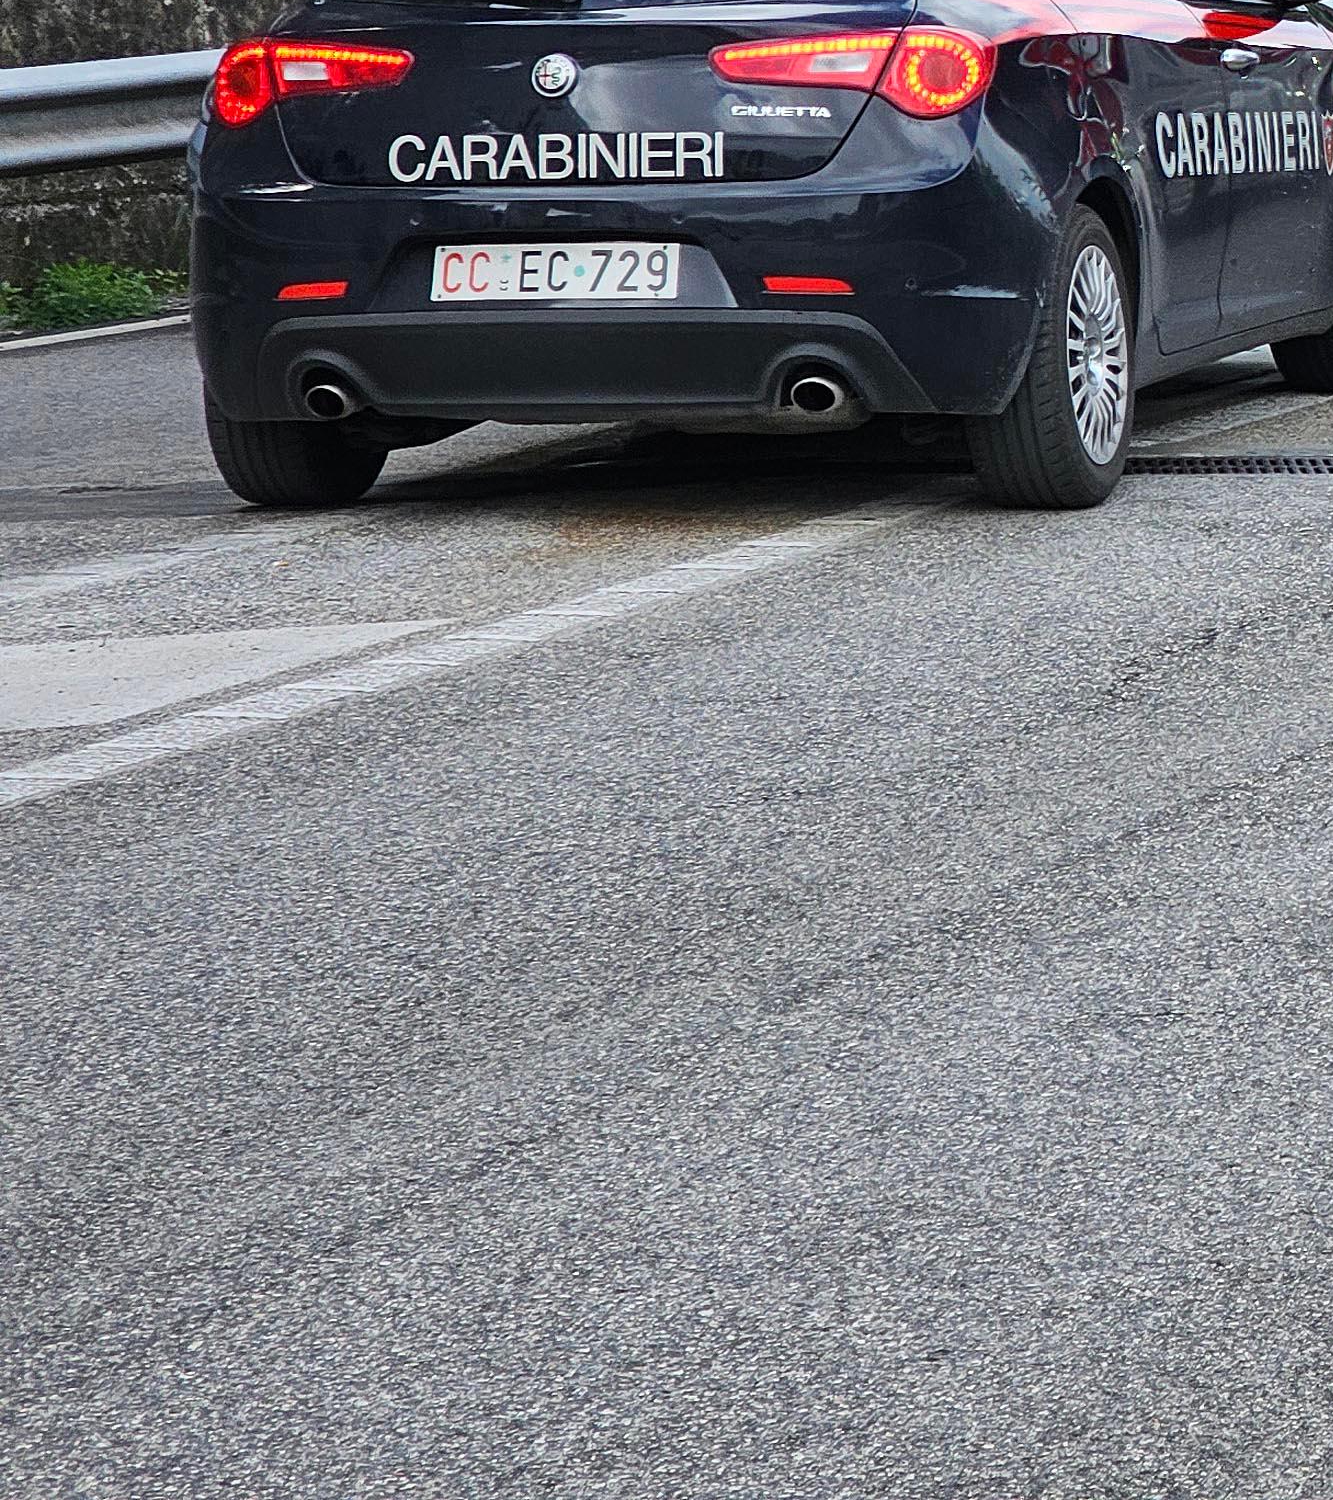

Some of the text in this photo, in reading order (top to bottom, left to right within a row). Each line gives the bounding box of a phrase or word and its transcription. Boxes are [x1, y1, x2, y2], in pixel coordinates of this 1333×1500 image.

[730, 105, 832, 118] GIULIETTA
[388, 131, 725, 183] CARABINIERI
[1155, 111, 1320, 179] CARABINIERI
[441, 248, 669, 293] CC EC 729
